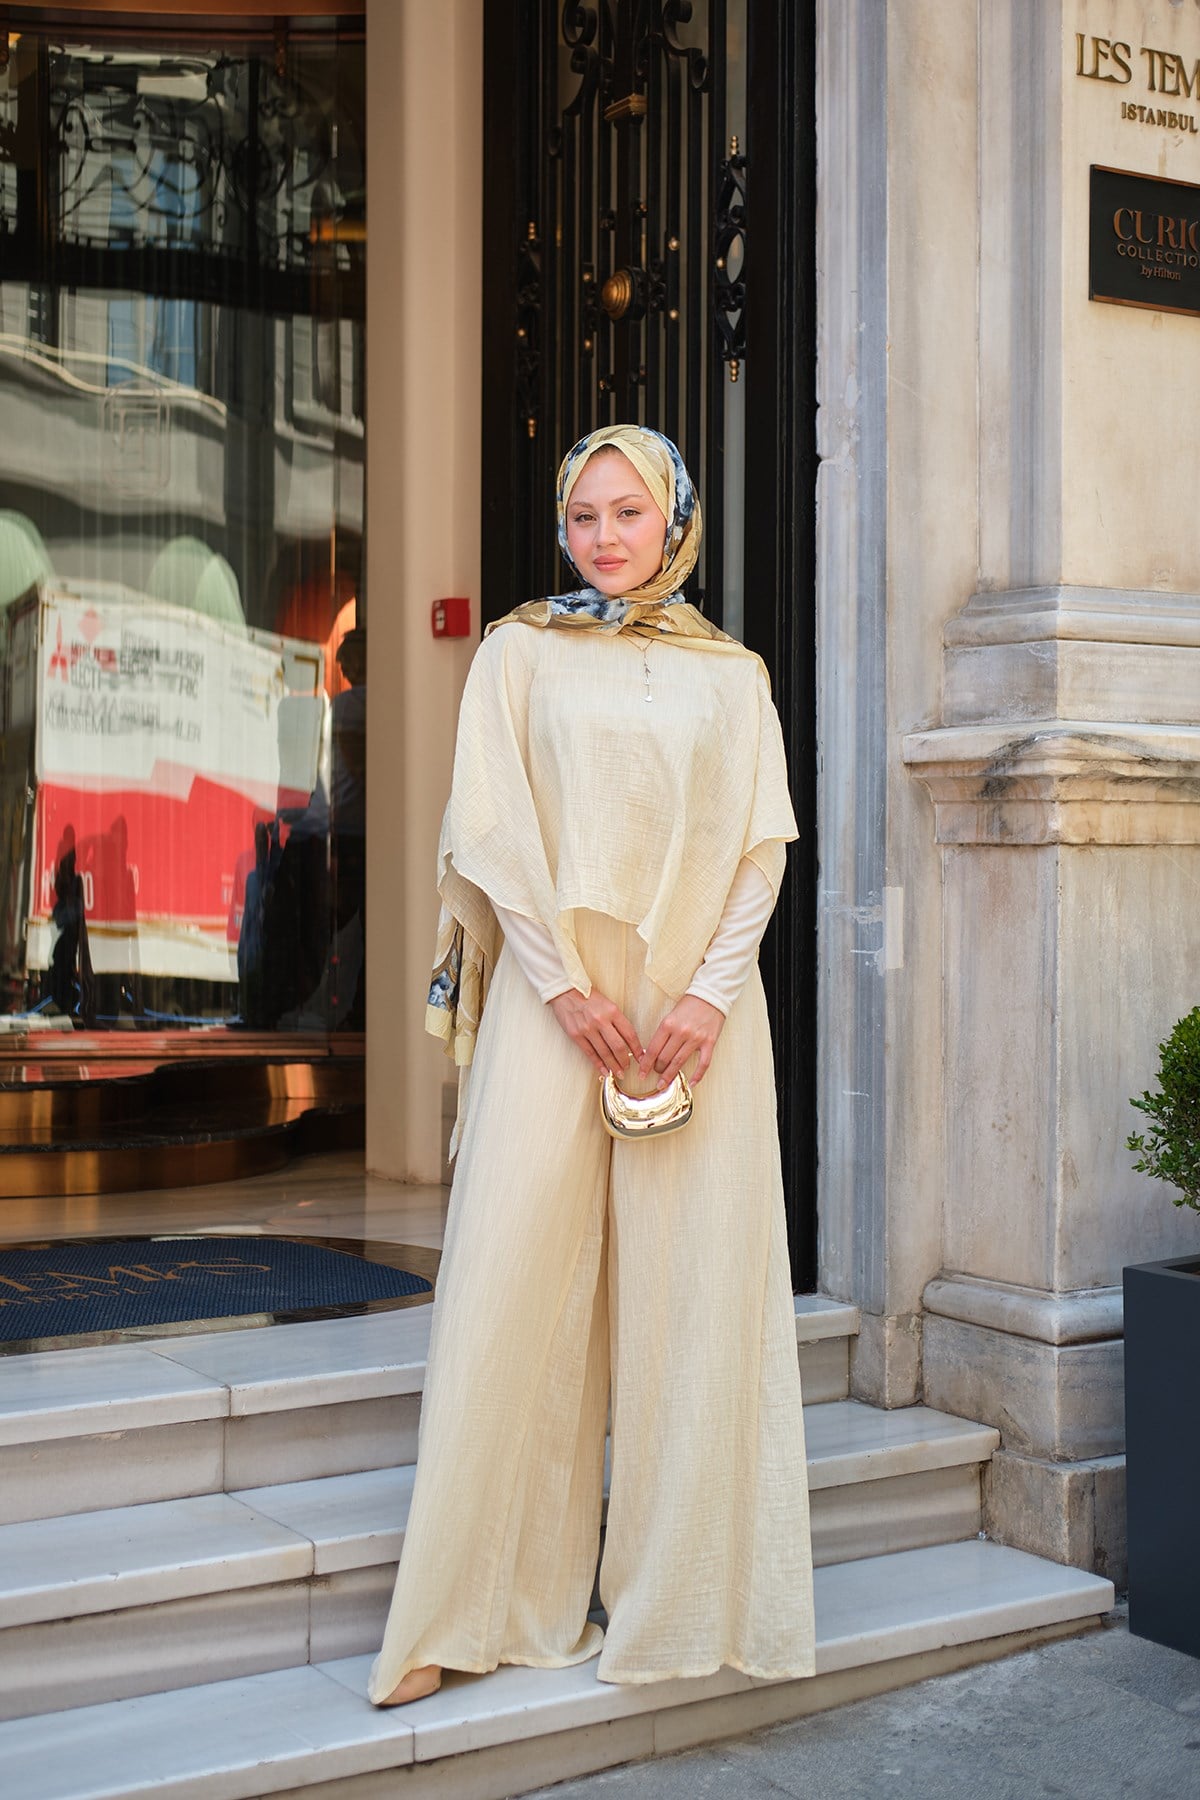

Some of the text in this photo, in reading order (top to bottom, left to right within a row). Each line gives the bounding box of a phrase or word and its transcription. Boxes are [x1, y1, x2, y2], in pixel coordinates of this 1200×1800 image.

[1075, 32, 1200, 101] LES TEM
[1121, 101, 1198, 134] ISTANBUL
[1117, 243, 1200, 268] COLLECTIO
[1141, 264, 1181, 281] by Hilton
